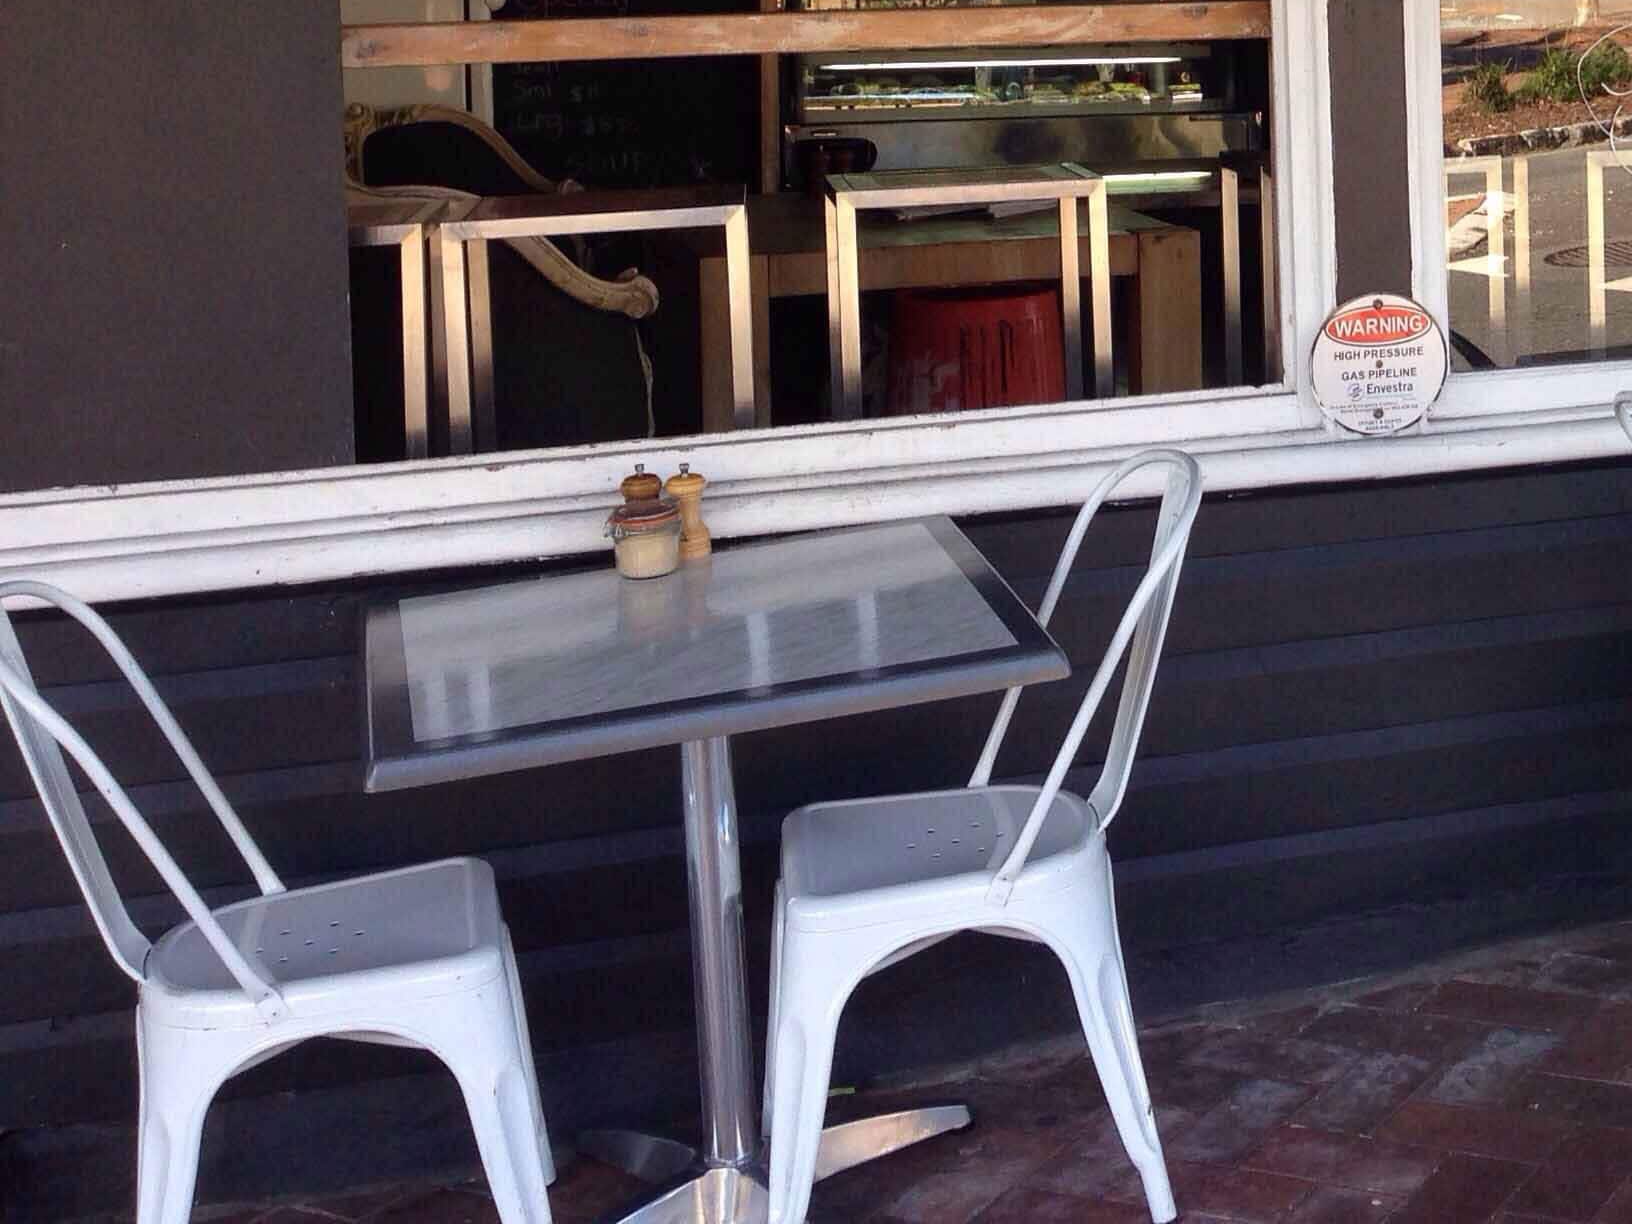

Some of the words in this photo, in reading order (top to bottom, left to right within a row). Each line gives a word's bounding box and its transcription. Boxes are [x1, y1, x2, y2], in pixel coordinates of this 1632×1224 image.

[1334, 315, 1423, 338] WARNING
[1334, 350, 1361, 361] HIGH
[1363, 346, 1424, 360] PRESSURE
[1341, 370, 1365, 381] GAS
[1368, 367, 1417, 379] PIPELINE
[1366, 383, 1414, 395] Envestra
